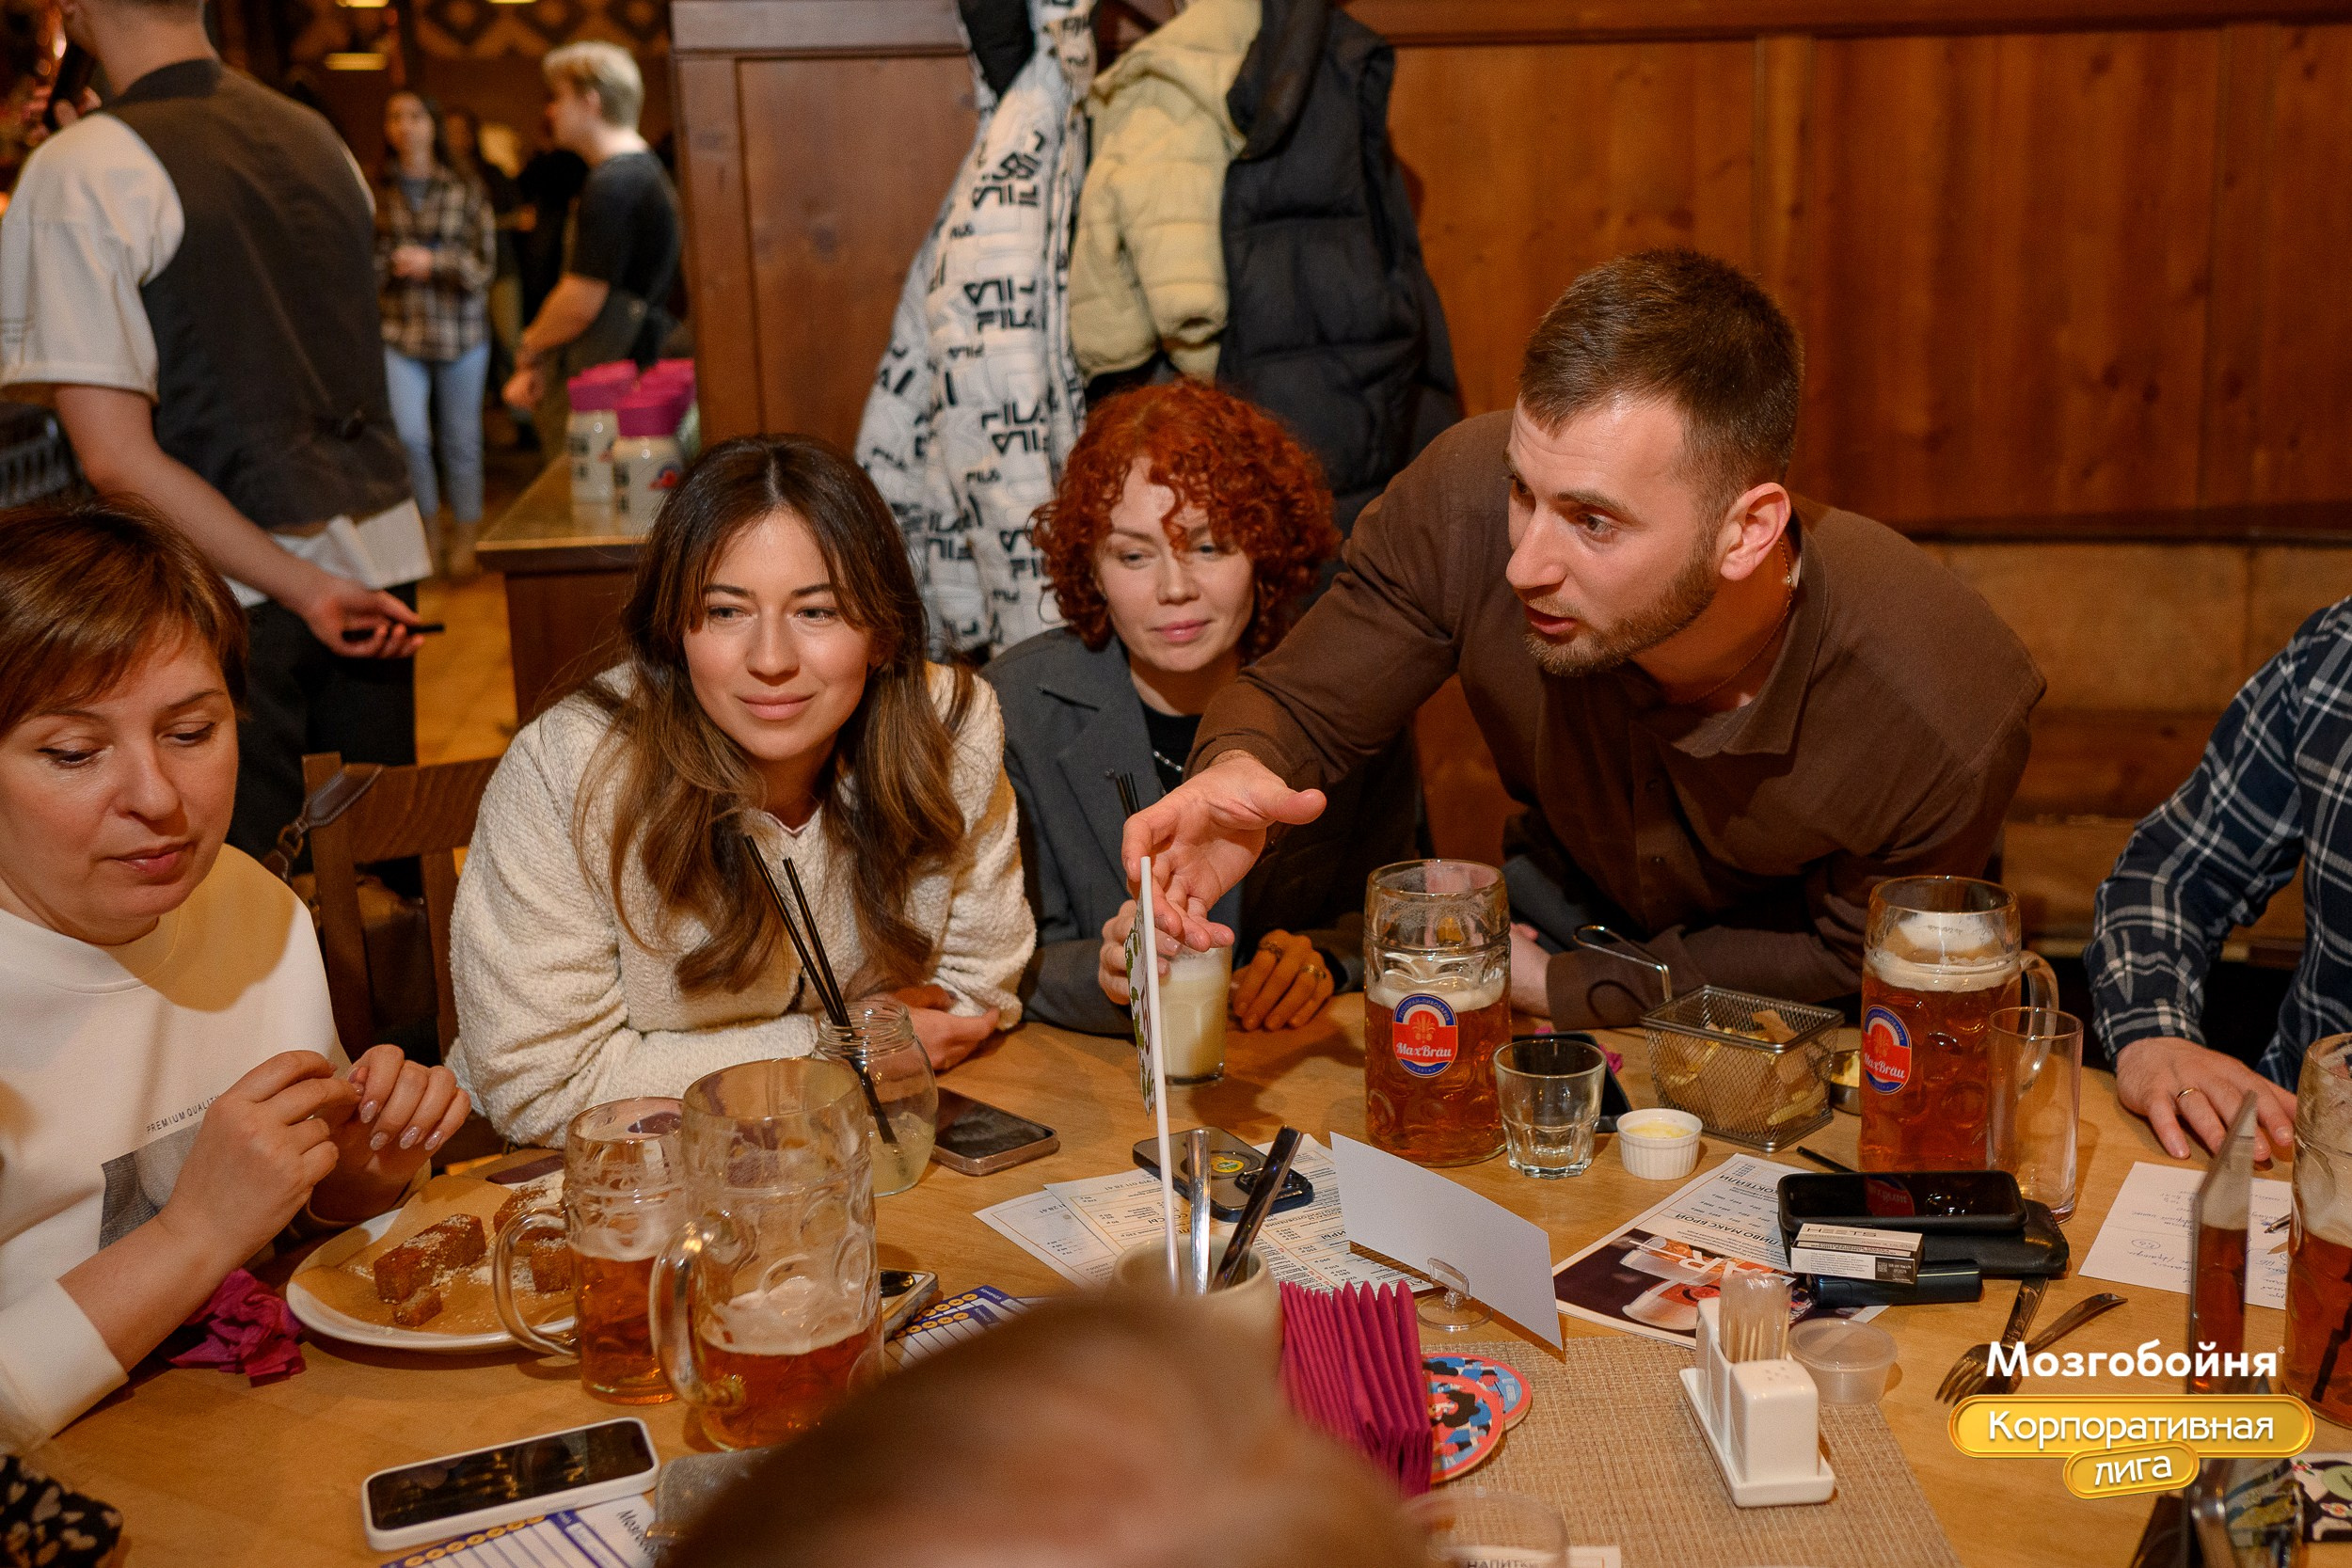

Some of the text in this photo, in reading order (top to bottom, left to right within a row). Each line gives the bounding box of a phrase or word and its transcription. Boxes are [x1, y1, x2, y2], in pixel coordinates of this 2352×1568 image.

[1395, 1041, 1452, 1057] MaxBräu
[147, 1111, 186, 1133] PREMIUM
[1321, 1230, 1346, 1240] ИРЫ
[1674, 1213, 1779, 1245] ПИВО МАКС БРОЙ
[1806, 1227, 1877, 1237] HEETS
